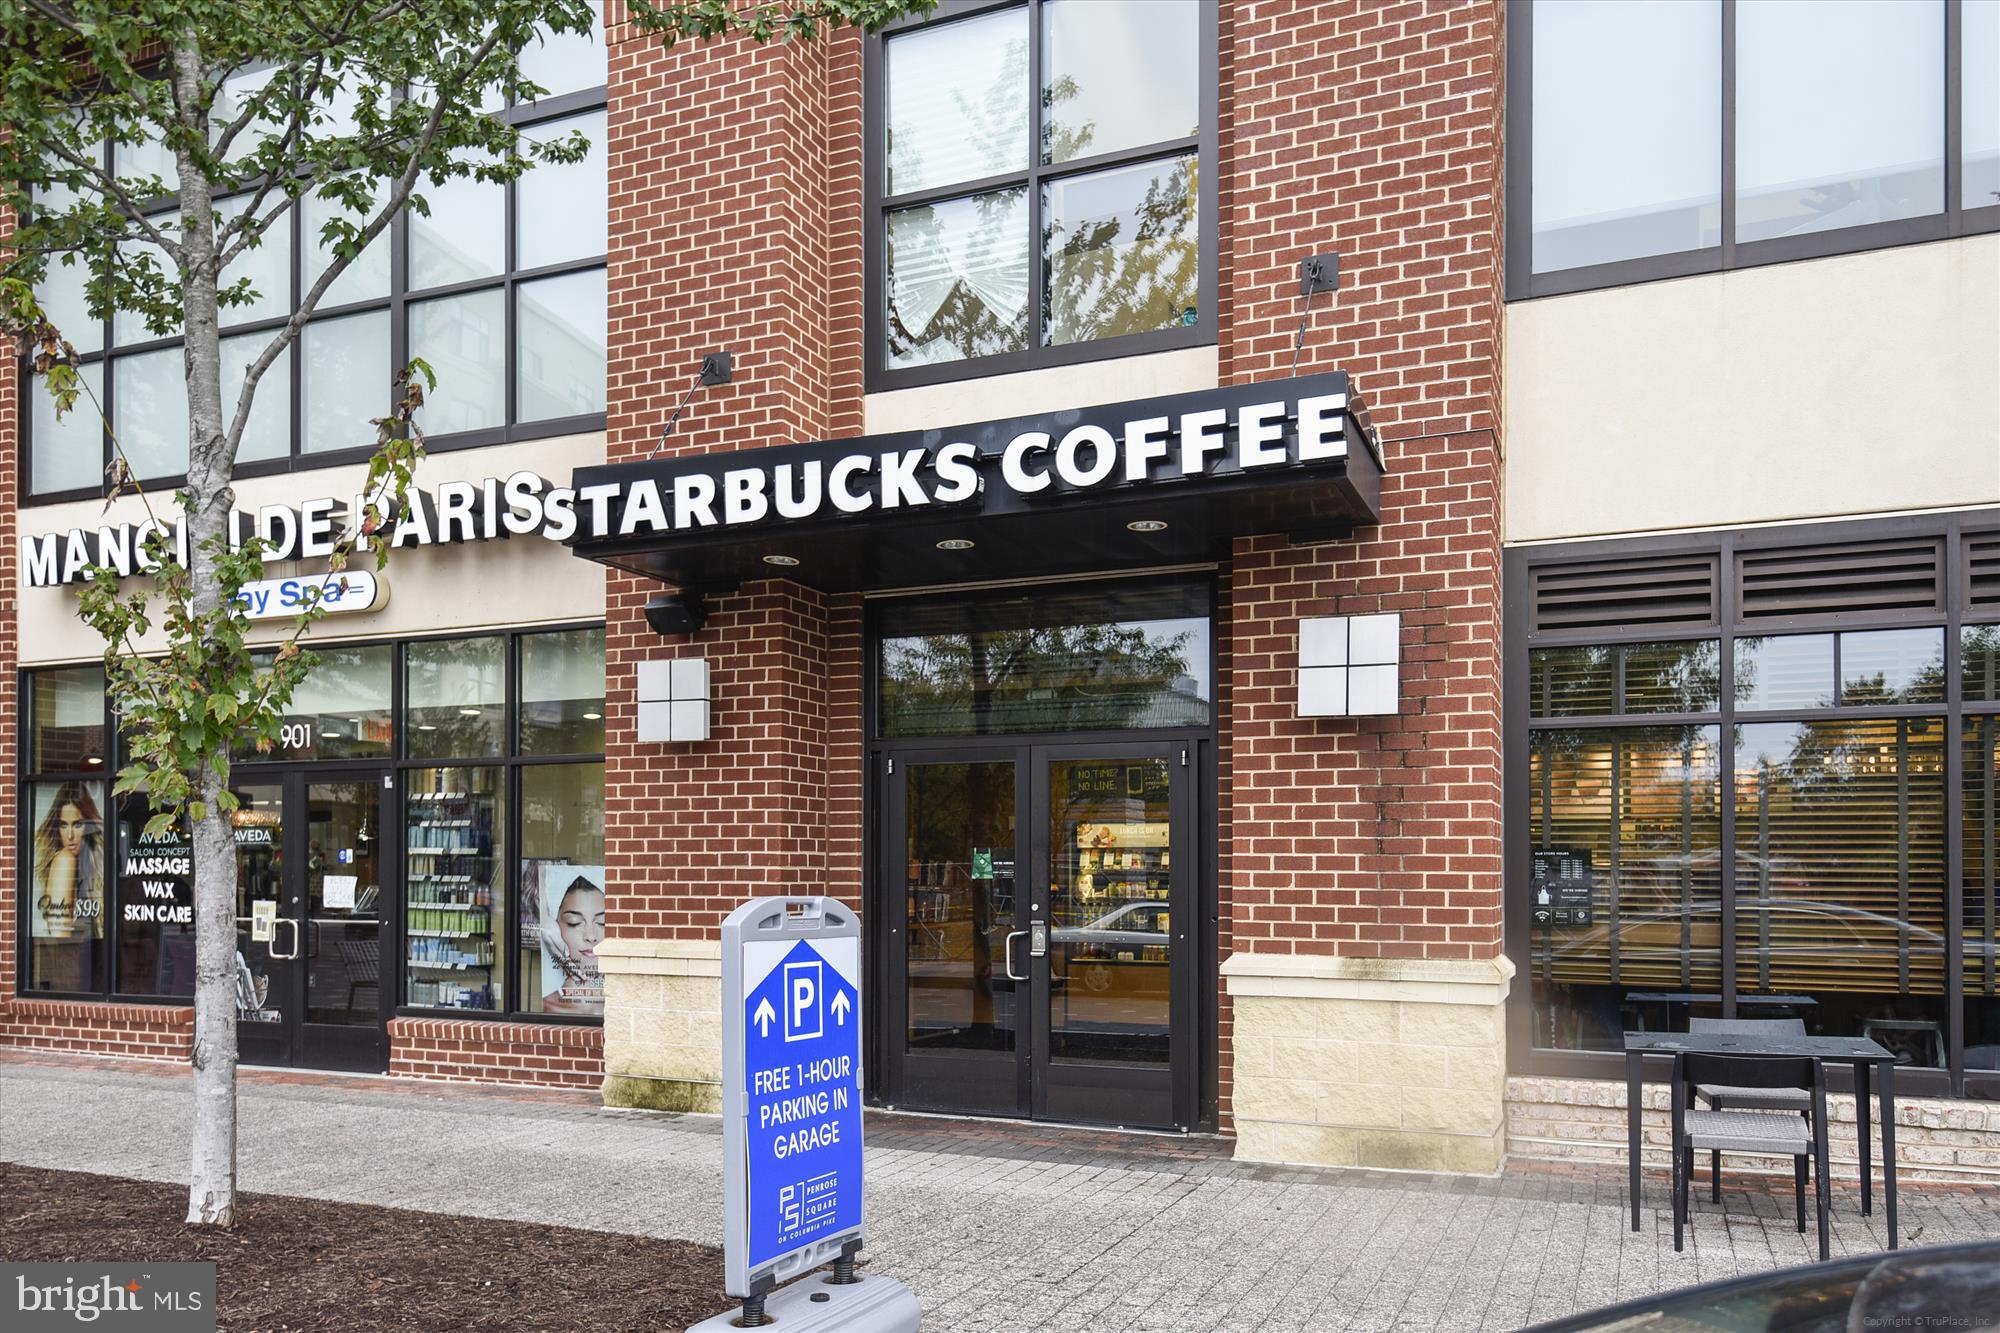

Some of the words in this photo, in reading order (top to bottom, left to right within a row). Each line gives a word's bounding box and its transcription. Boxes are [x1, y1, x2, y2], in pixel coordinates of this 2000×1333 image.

[542, 442, 978, 541] STARBUCKS
[1002, 393, 1348, 493] COFFEE
[21, 508, 242, 587] MANCII
[260, 498, 335, 563] DE
[356, 470, 544, 552] PARIS
[280, 580, 342, 611] Spa
[280, 723, 311, 749] 901
[1078, 769, 1091, 779] NO
[1078, 782, 1091, 791] NO
[129, 848, 155, 857] SALON
[157, 847, 191, 856] CONCEPT
[125, 857, 190, 876] MASSAGE
[142, 880, 175, 899] WAX
[73, 898, 101, 920] $99
[124, 903, 155, 922] SKIN
[156, 904, 192, 923] CARE
[793, 977, 815, 1028] P
[755, 1066, 791, 1096] FREE
[797, 1055, 850, 1086] 1-HOUR
[760, 1091, 829, 1129] PARKING
[833, 1086, 849, 1111] IN
[773, 1120, 841, 1160] GARAGE
[806, 1177, 838, 1196] PENROSE
[805, 1197, 837, 1217] SQUARE
[789, 1223, 820, 1240] COLUMBIA
[822, 1216, 836, 1227] PIKE
